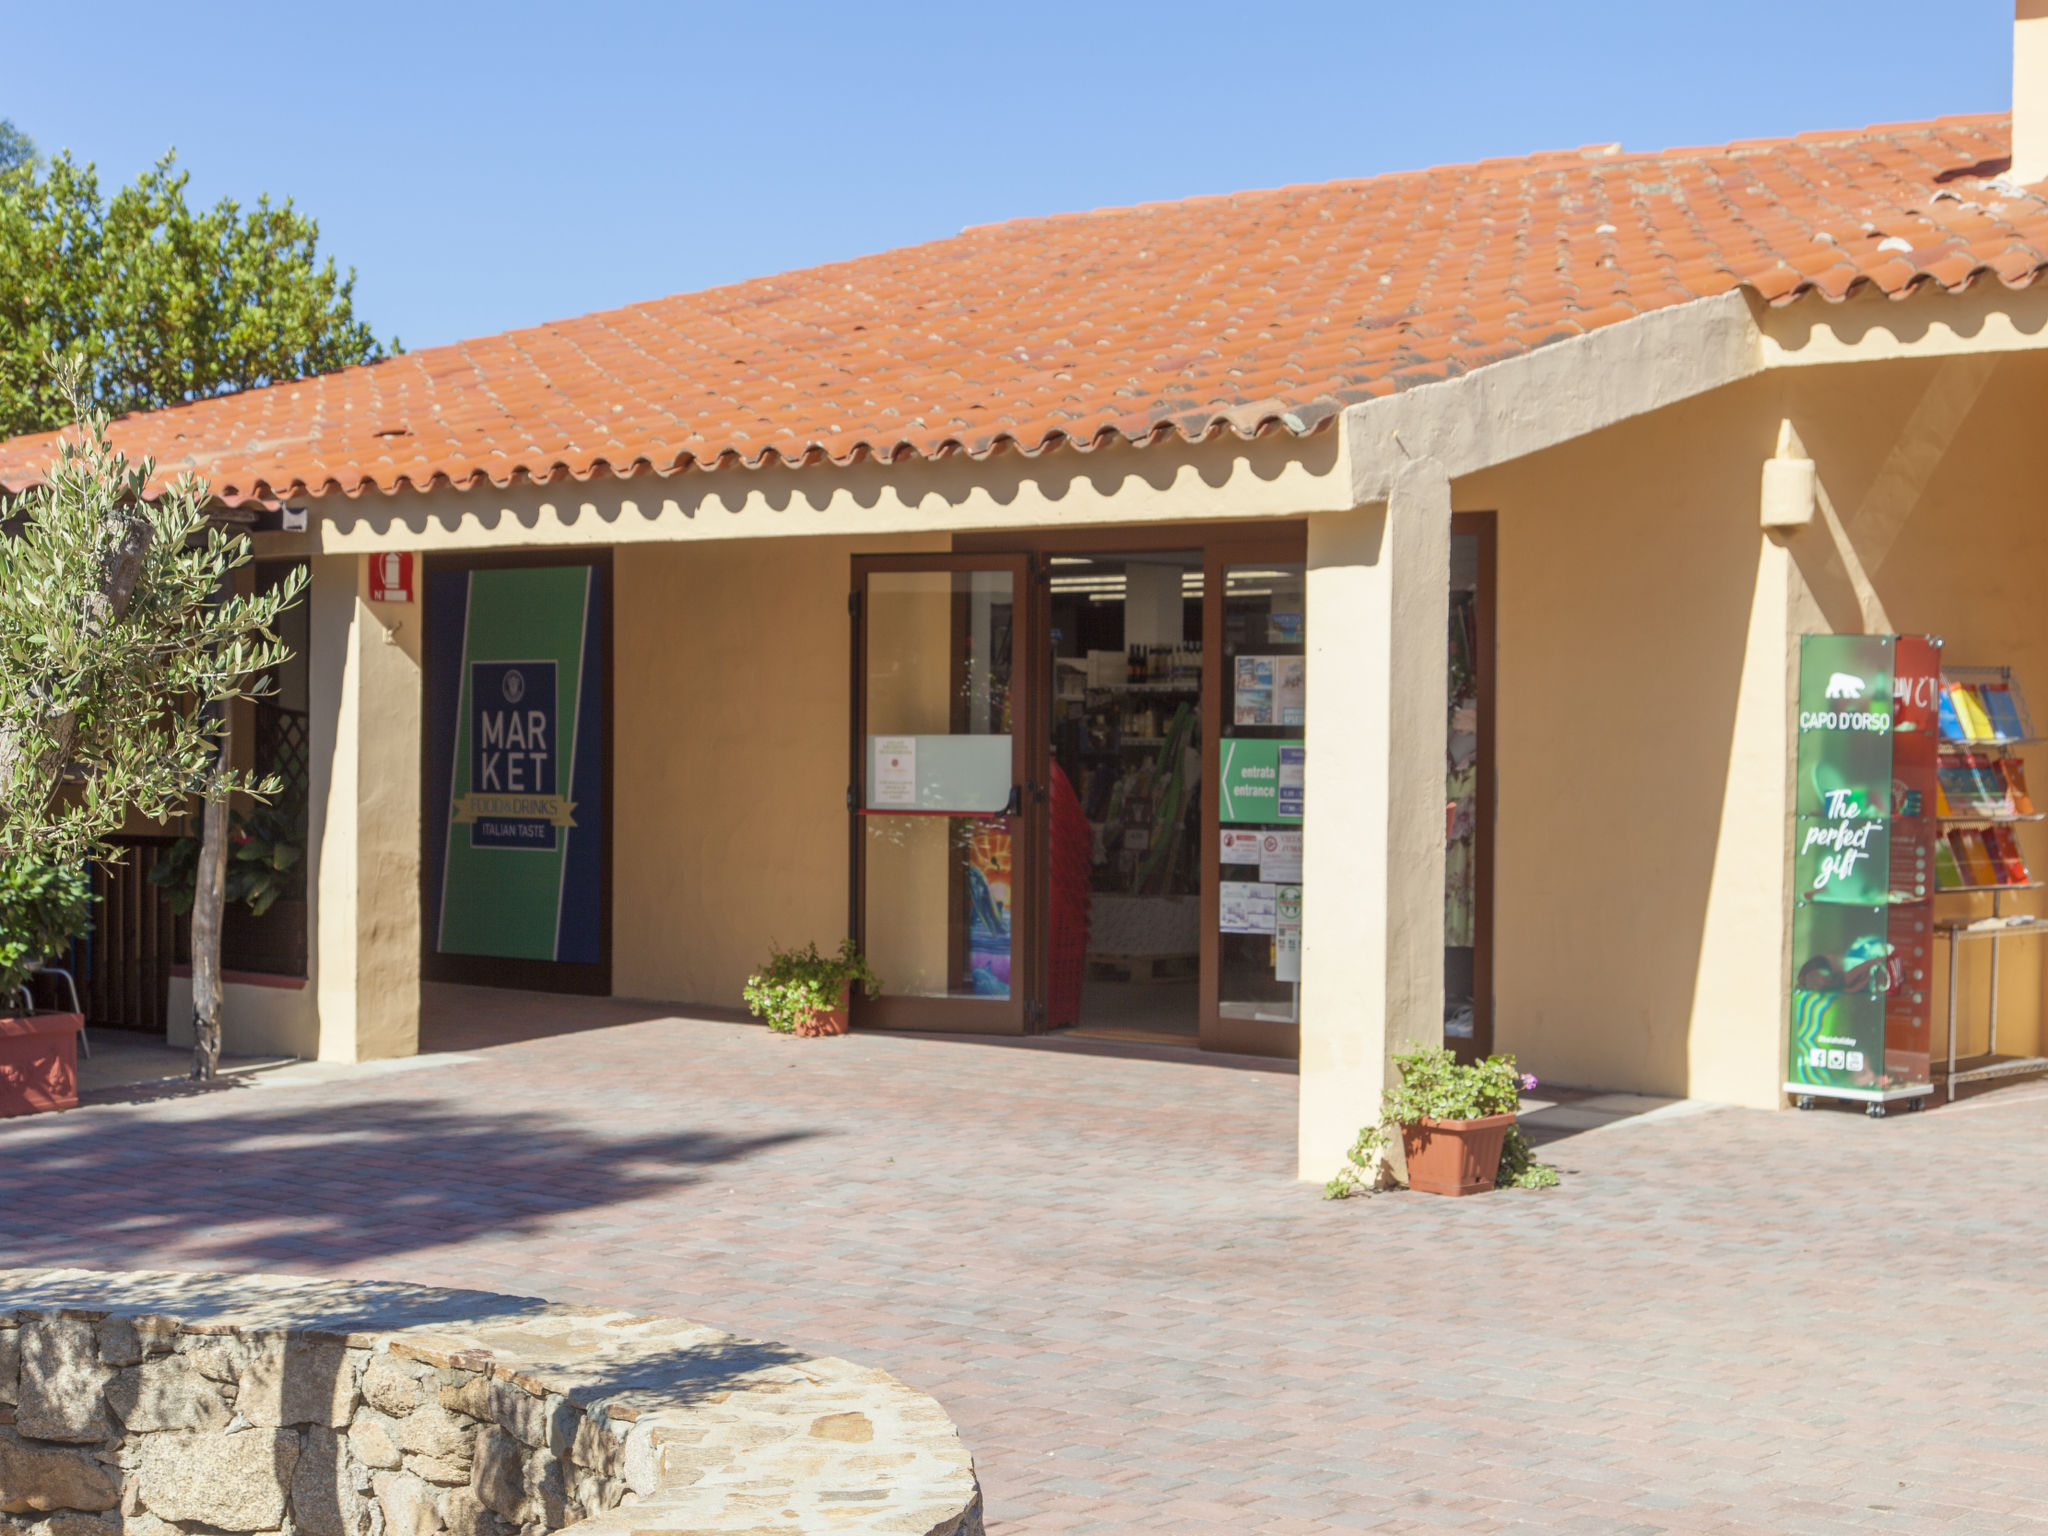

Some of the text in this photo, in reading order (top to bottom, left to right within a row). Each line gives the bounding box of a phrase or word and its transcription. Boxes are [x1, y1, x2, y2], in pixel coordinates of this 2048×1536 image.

[481, 710, 547, 750] MAR
[1800, 711, 1891, 731] CAPO D'ORSO
[481, 752, 548, 792] KET
[1241, 766, 1275, 779] entrata
[1233, 784, 1275, 797] entrance
[1825, 788, 1861, 820] The
[482, 822, 545, 838] ITALIAN TASTE
[1801, 819, 1884, 855] perfect
[1813, 848, 1870, 890] gift
